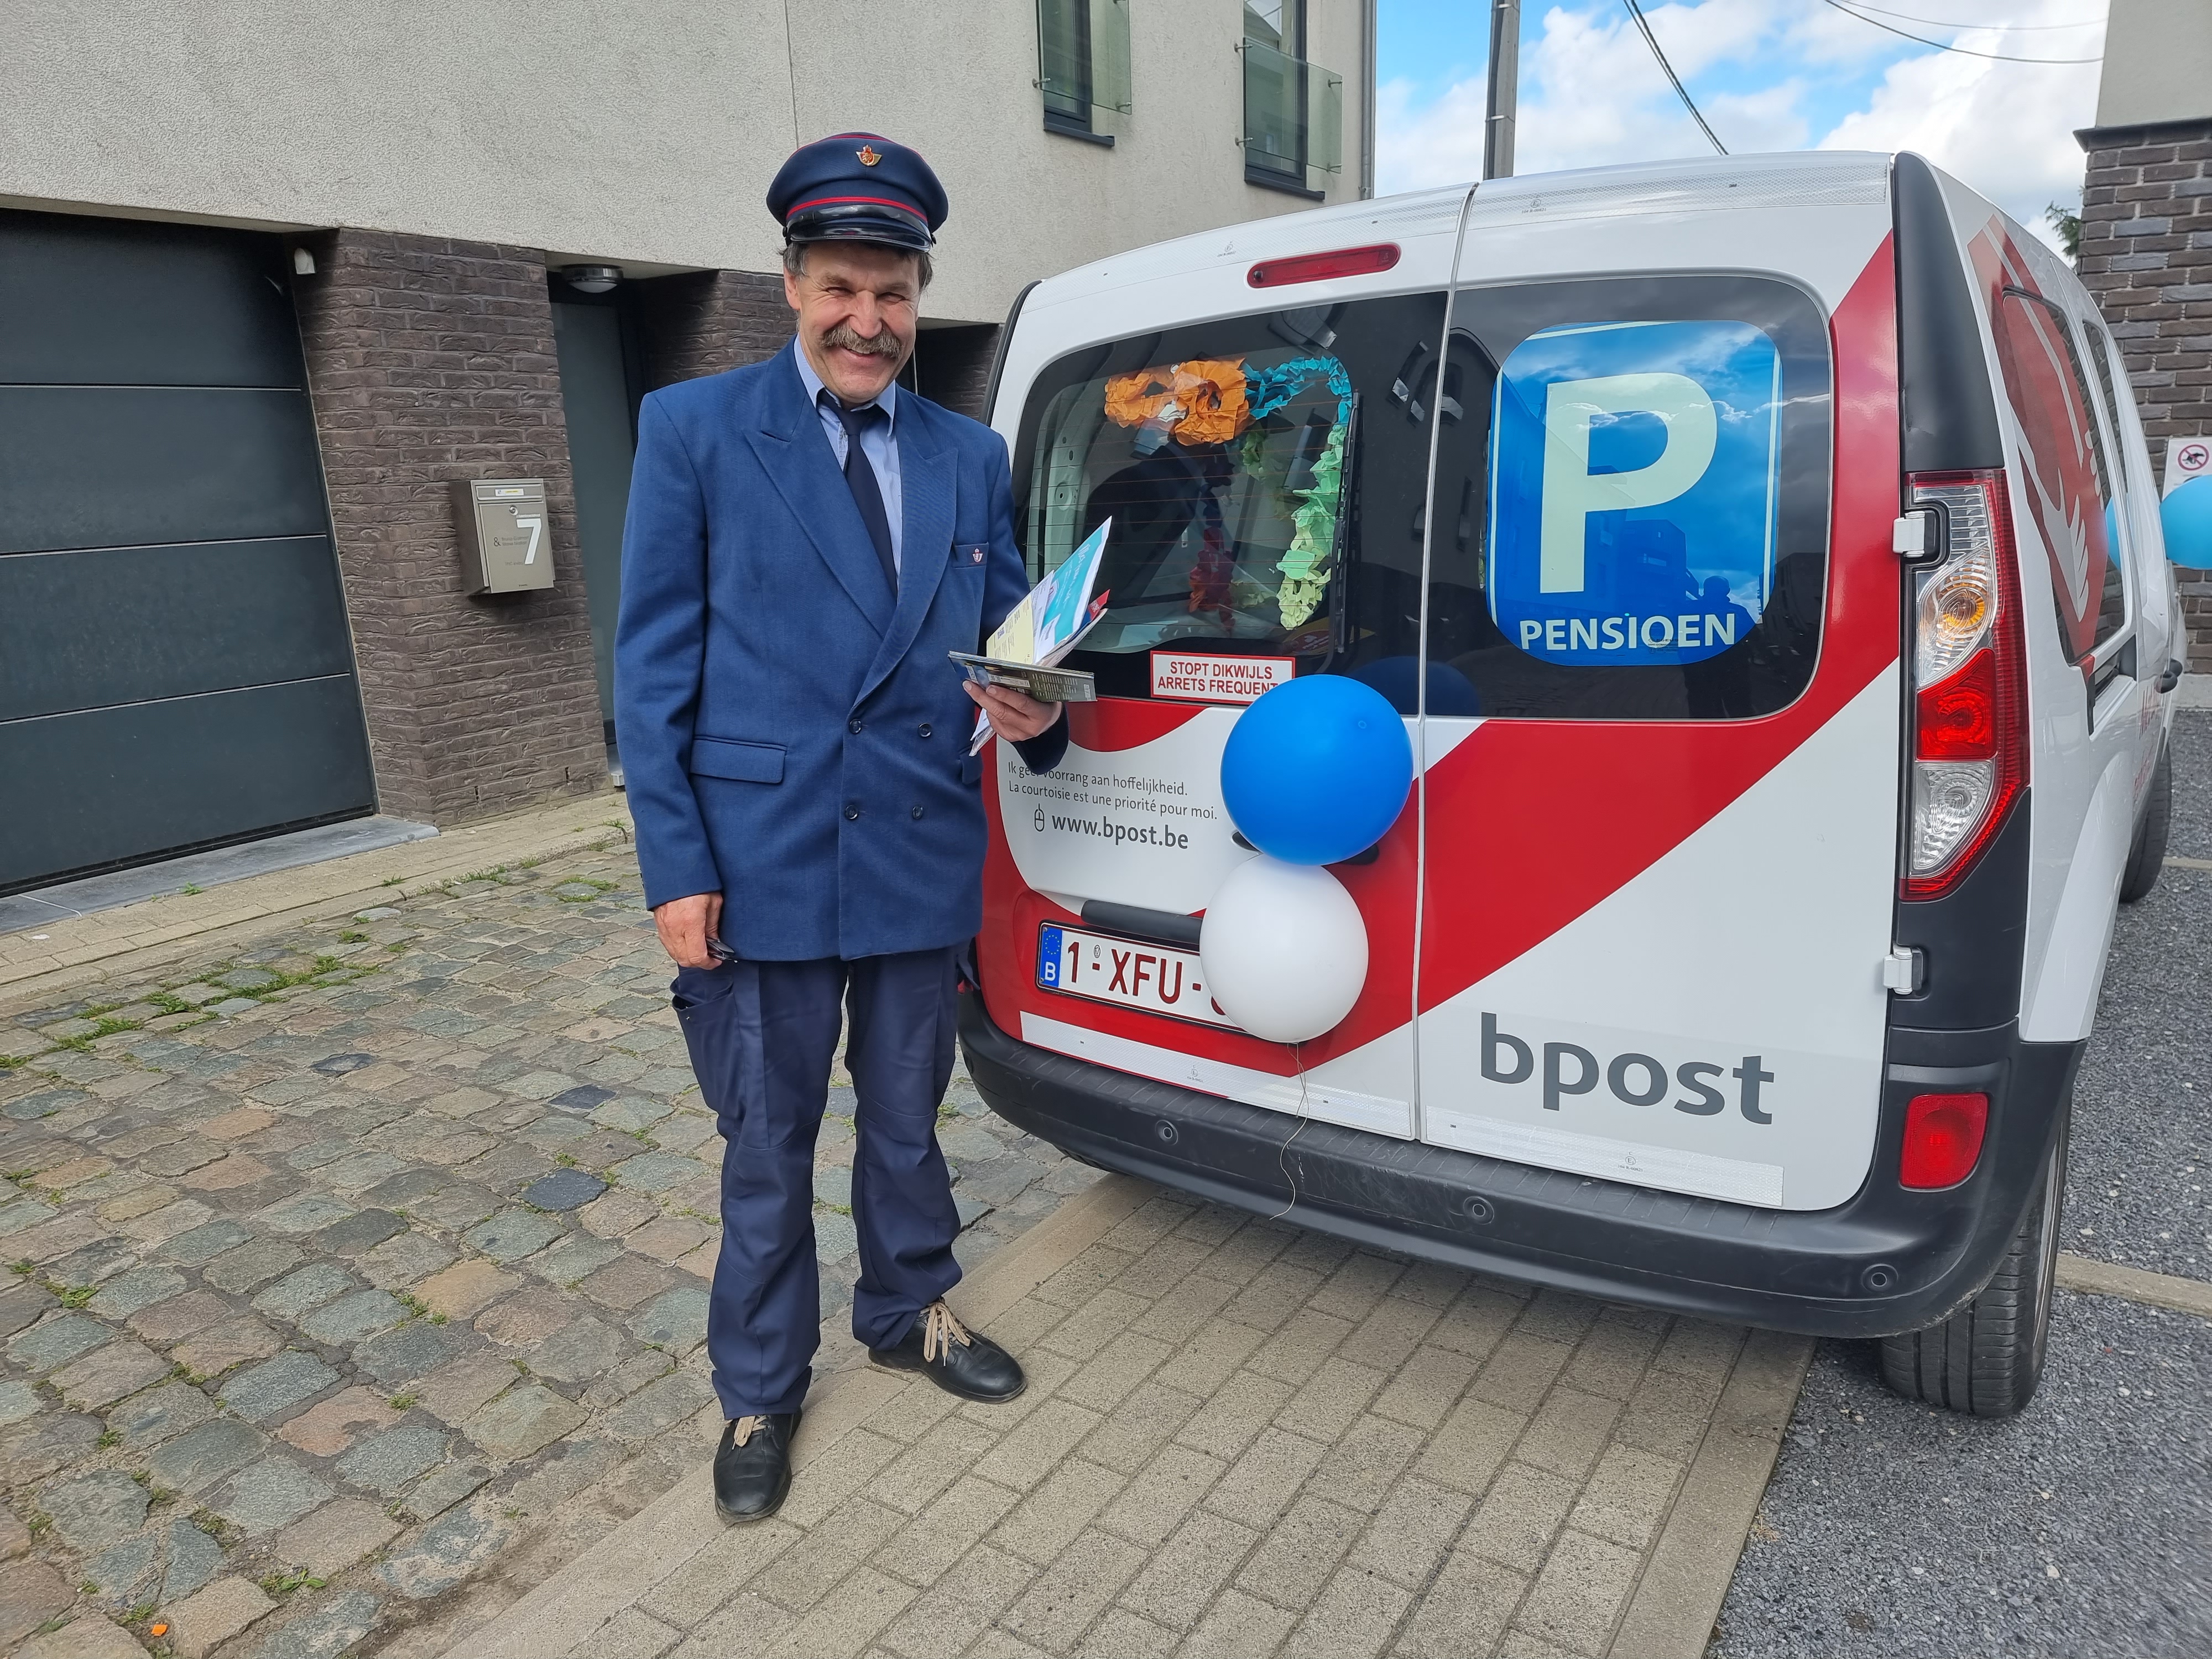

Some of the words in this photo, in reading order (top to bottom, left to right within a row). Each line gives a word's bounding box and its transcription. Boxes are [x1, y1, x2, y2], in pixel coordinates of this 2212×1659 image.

[1540, 373, 1717, 593] P
[516, 518, 542, 565] 7
[1520, 612, 1735, 650] PENSIOEN
[1157, 676, 1206, 692] ARRETS
[1170, 661, 1209, 676] STOPT
[1213, 664, 1272, 680] DIKWIJLS
[1008, 760, 1016, 774] Ik
[1091, 775, 1110, 786] aan
[1113, 774, 1188, 796] hoffelijkheid.
[1009, 780, 1019, 792] La
[1021, 786, 1071, 800] courtoisie
[1073, 792, 1089, 803] est
[1092, 795, 1112, 806] une
[1115, 796, 1156, 812] priorité
[1160, 804, 1188, 817] pour
[1191, 806, 1217, 820] moi.
[1051, 815, 1188, 849] www.bpost.be
[1045, 961, 1056, 981] B
[1068, 941, 1226, 1015] 1-XFU-
[1481, 1011, 1775, 1125] bpost
